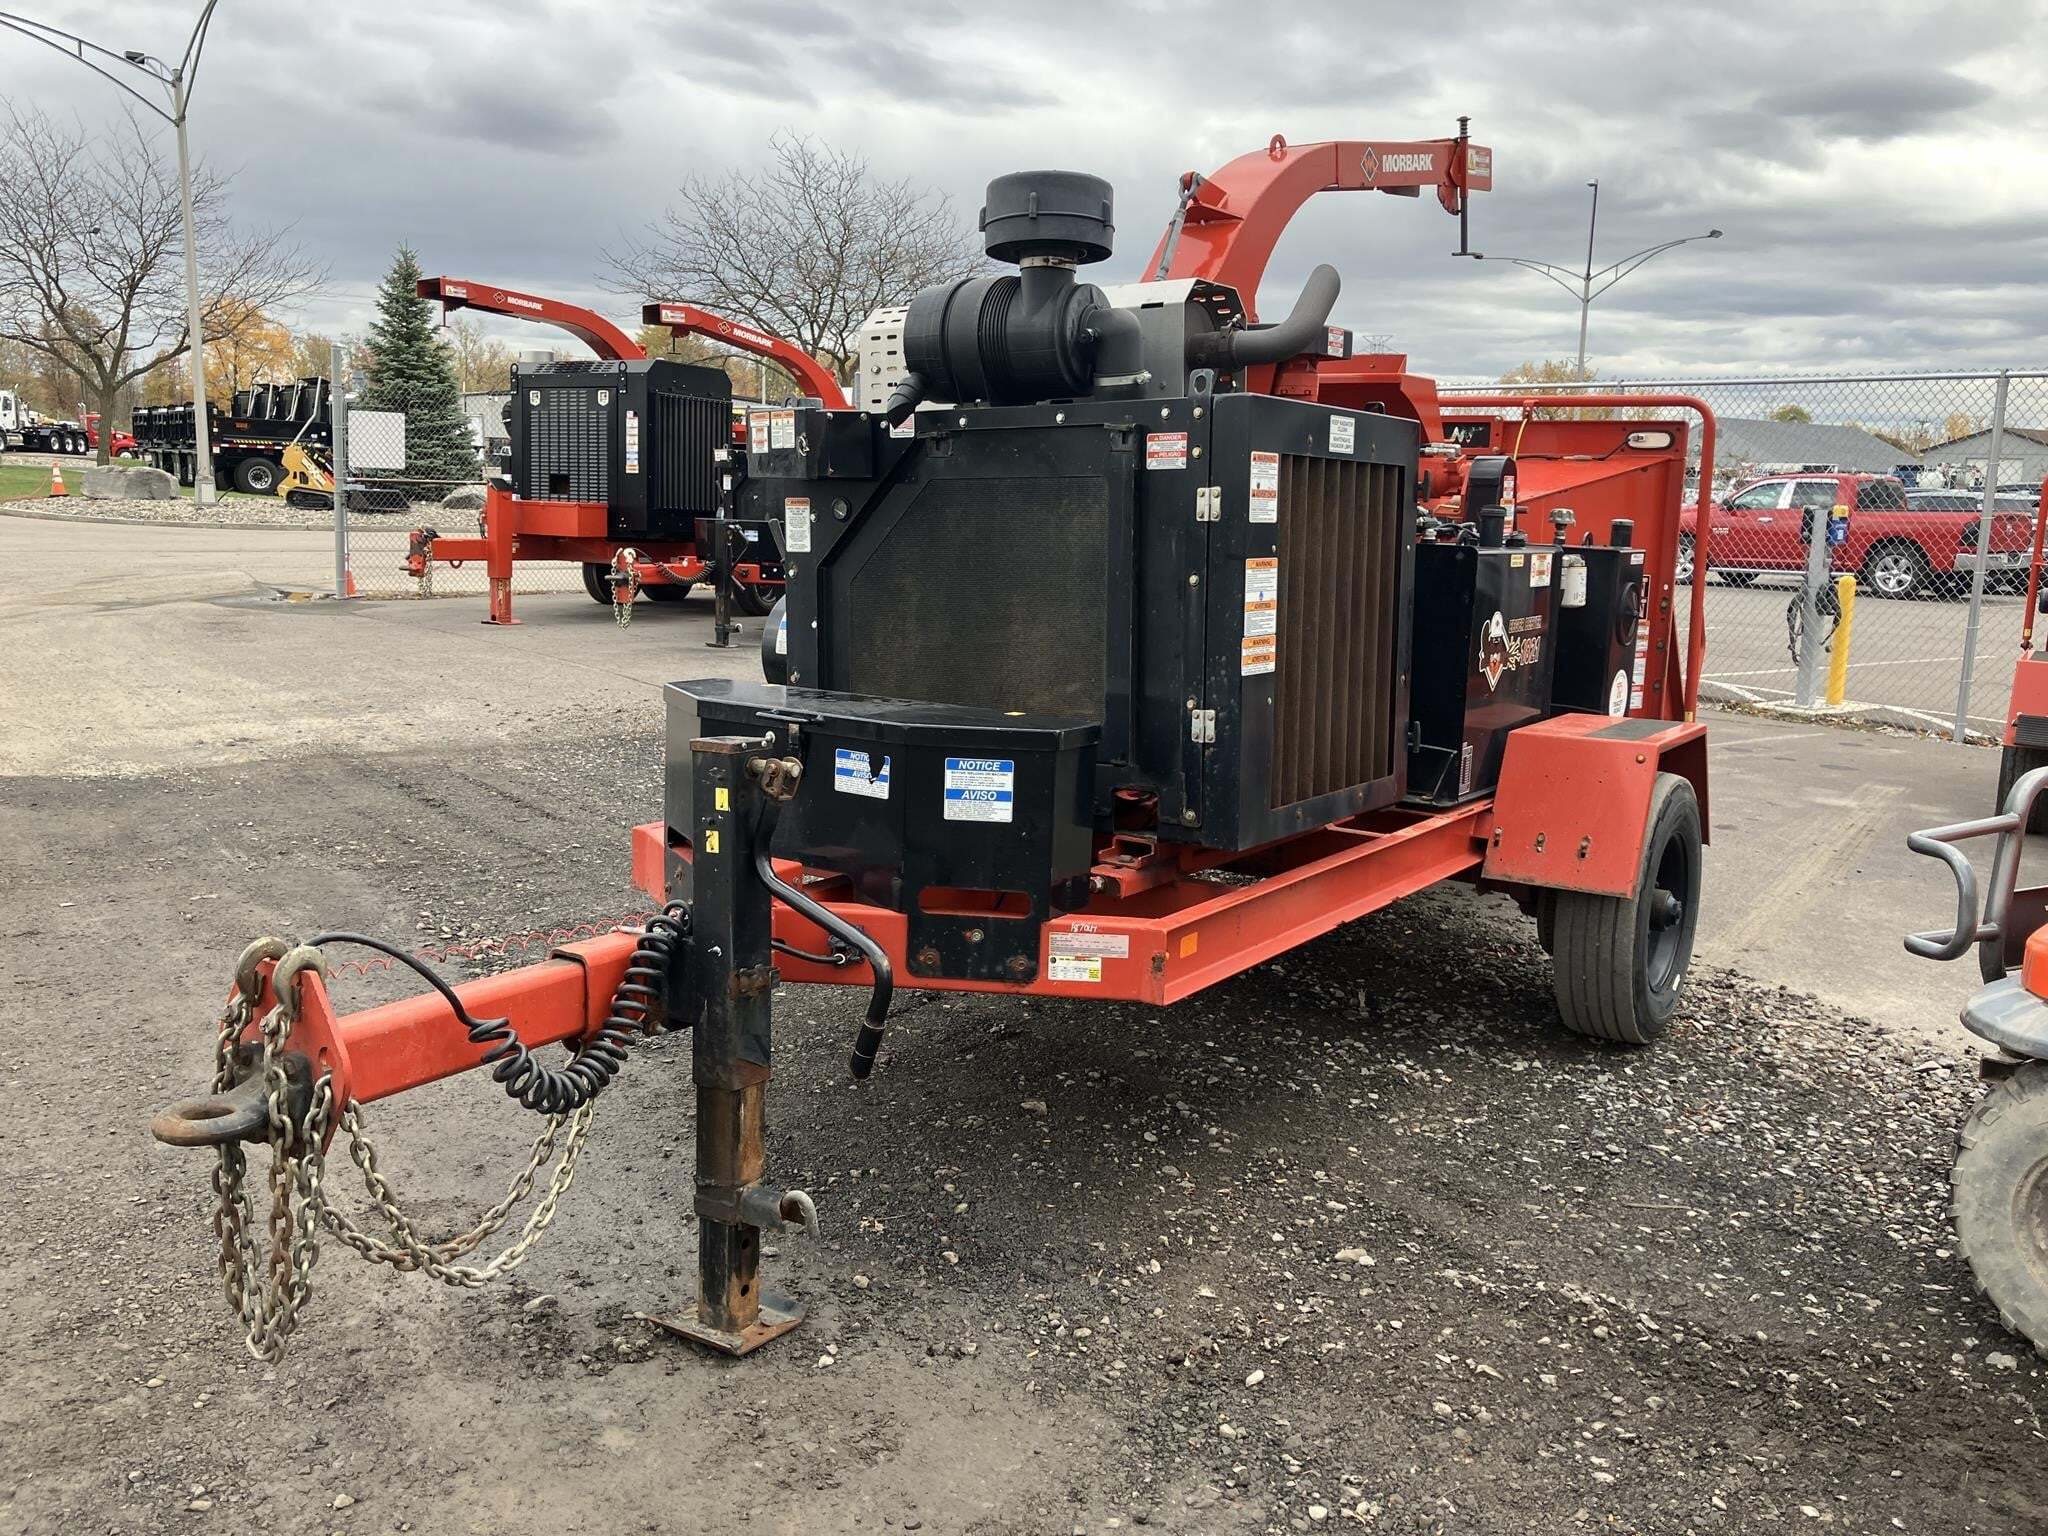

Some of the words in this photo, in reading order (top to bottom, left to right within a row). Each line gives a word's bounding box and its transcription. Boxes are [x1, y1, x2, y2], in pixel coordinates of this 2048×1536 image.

[1382, 154, 1433, 172] MORBARK
[507, 296, 544, 311] MORBARK
[732, 328, 774, 348] MORBARK
[849, 752, 870, 762] NOTIC
[958, 760, 1001, 771] NOTICE
[961, 790, 997, 801] AVISO
